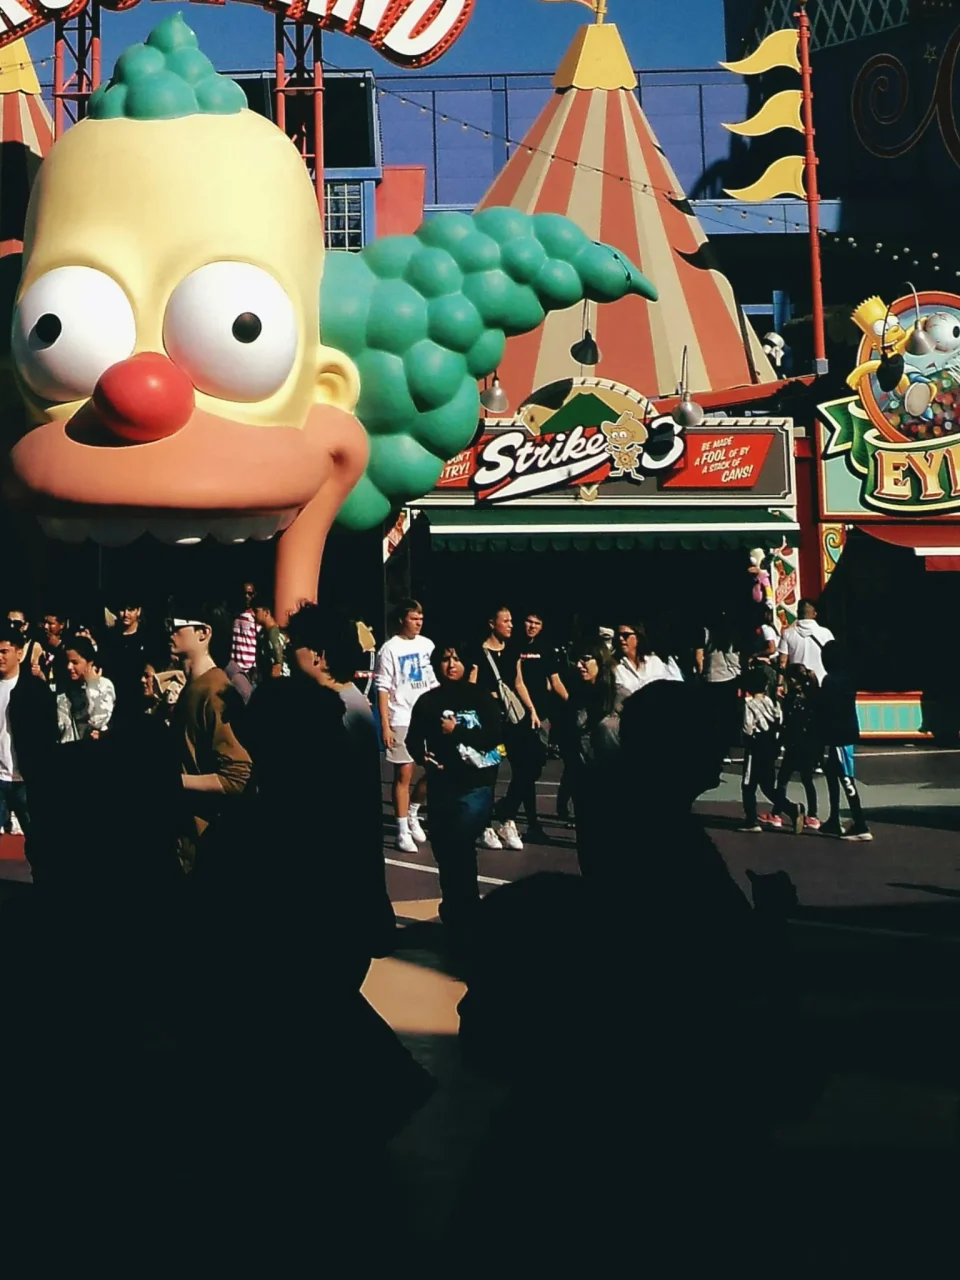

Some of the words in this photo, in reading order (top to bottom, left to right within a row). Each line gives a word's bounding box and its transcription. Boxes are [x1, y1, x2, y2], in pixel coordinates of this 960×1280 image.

[701, 441, 712, 451] BE
[712, 436, 734, 448] MADE
[474, 426, 610, 485] Strike
[694, 457, 701, 466] A
[700, 448, 726, 465] FOOL
[739, 445, 751, 456] BY
[701, 465, 708, 475] A
[708, 460, 732, 472] STACK
[721, 464, 754, 483] CANS!
